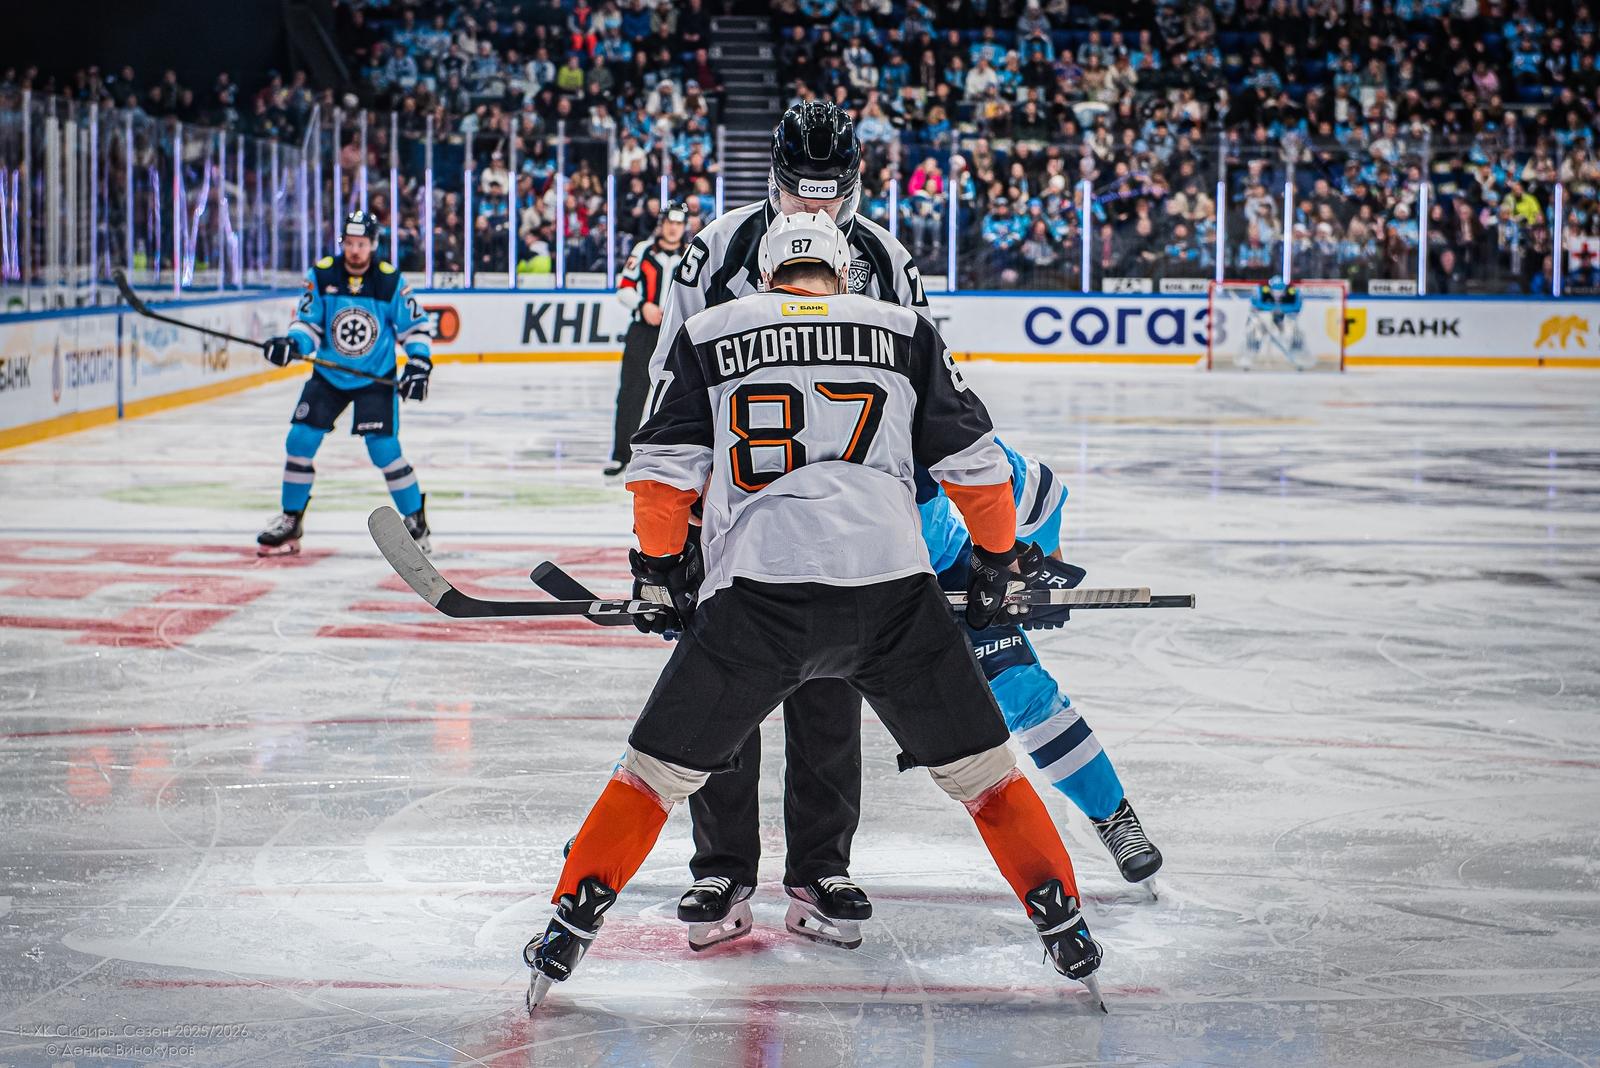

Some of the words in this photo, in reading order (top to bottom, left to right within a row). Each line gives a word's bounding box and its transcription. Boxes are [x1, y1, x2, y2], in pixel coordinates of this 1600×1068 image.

[800, 184, 835, 193] согаз
[791, 238, 813, 254] 87
[681, 244, 705, 283] 5
[1025, 306, 1227, 346] согаз
[1377, 318, 1460, 337] БАНК
[715, 326, 895, 377] GIZDATULLIN
[729, 380, 888, 495] 87
[588, 600, 662, 615] CC
